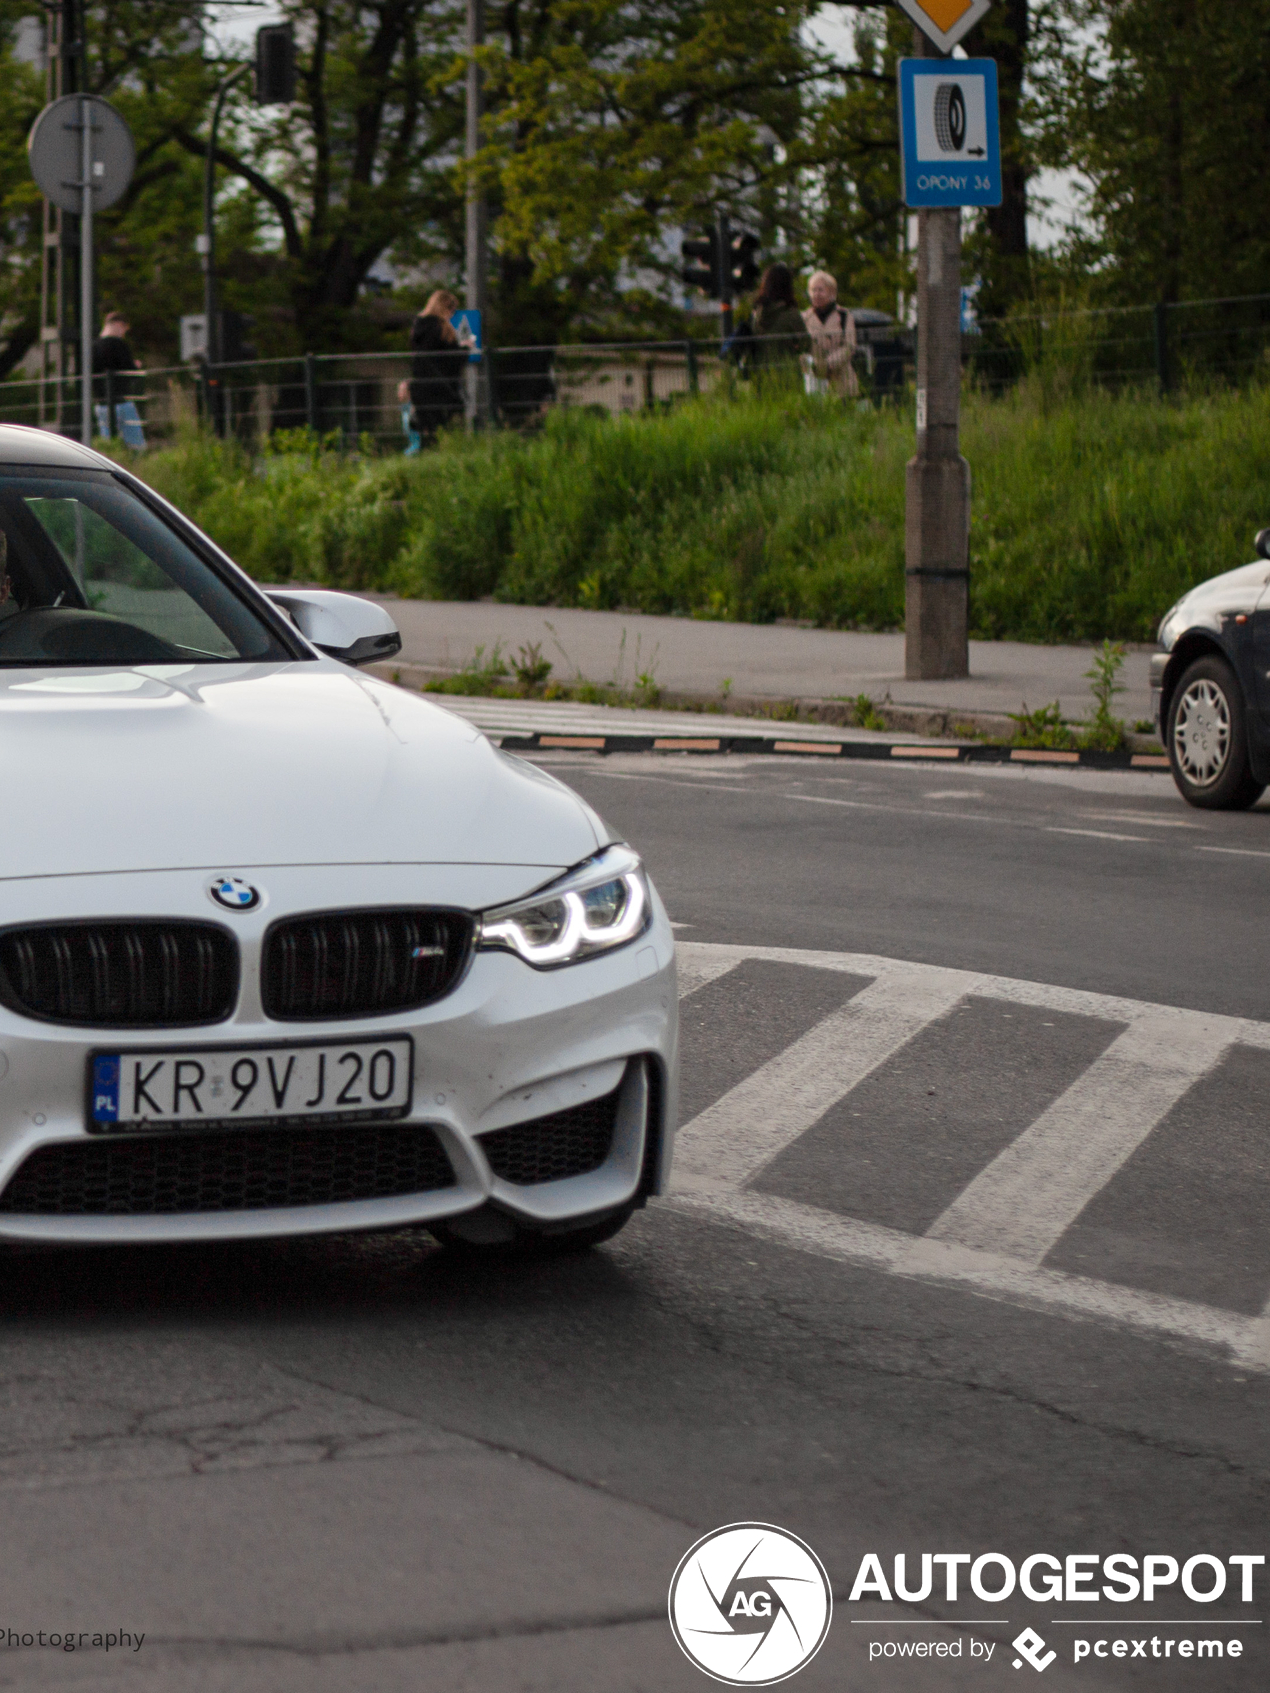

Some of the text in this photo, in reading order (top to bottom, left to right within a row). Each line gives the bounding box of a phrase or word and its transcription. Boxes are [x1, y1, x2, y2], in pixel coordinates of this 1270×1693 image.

[916, 174, 991, 191] OPONY 36
[133, 1048, 396, 1114] KR 9VJ20
[95, 1096, 116, 1111] PL
